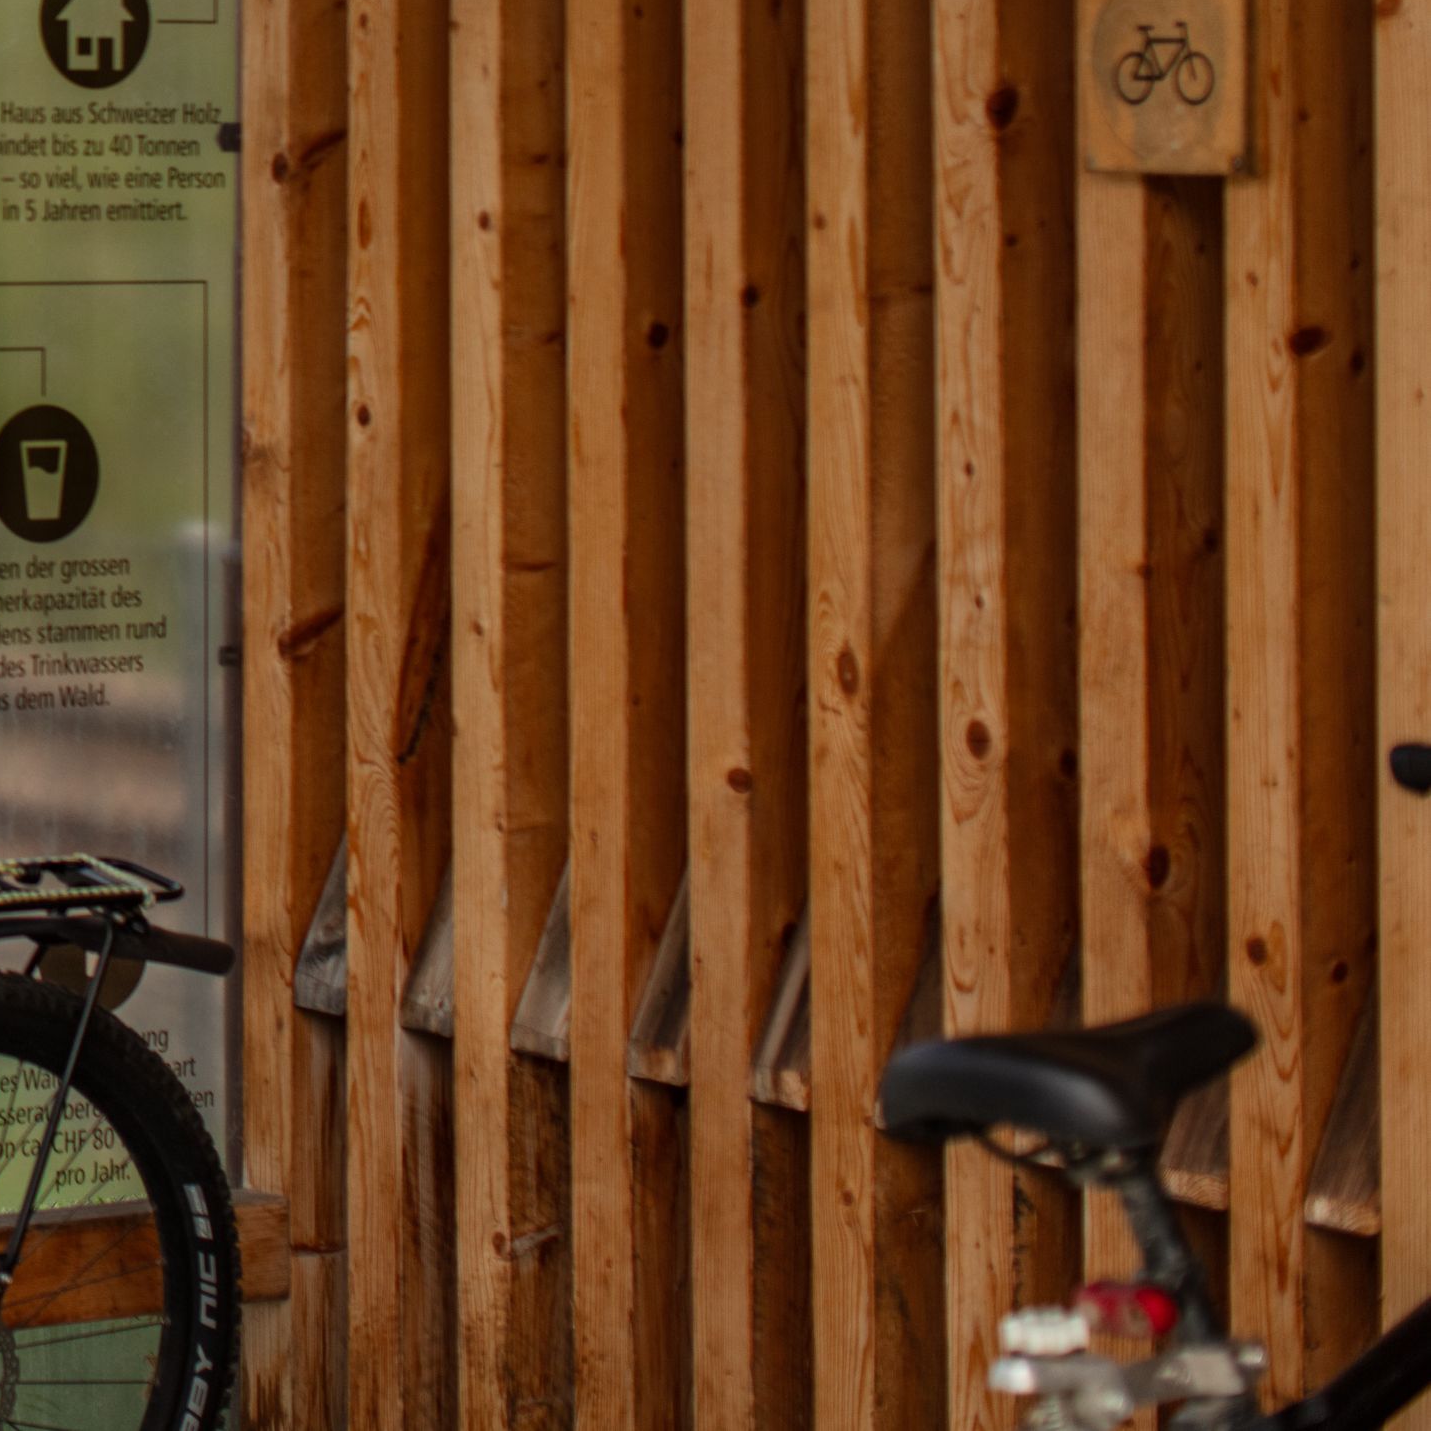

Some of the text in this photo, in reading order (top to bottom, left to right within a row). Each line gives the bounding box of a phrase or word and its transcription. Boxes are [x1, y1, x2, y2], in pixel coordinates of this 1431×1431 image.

[0, 101, 46, 124] Haus
[51, 105, 83, 124] aus
[87, 101, 177, 124] Schweizer
[182, 103, 222, 124] Holz
[51, 133, 79, 157] bis
[83, 139, 104, 157] zu
[109, 134, 132, 157] 40
[136, 134, 200, 157] Tonnen
[19, 170, 40, 189] so
[45, 166, 83, 192] viel,
[86, 167, 117, 189] wie
[124, 167, 162, 189] eine
[167, 167, 226, 189] Person
[2, 199, 187, 221] in 5 Jahren emittiert.
[25, 555, 56, 579] der
[60, 557, 131, 584] grossen
[111, 585, 143, 609] des
[36, 620, 121, 644] stammen
[126, 615, 167, 640] rund
[30, 651, 144, 677] Trinkwassers
[15, 687, 55, 710] dem
[58, 683, 110, 708] Wald.
[56, 1158, 131, 1193] pro Jahr.
